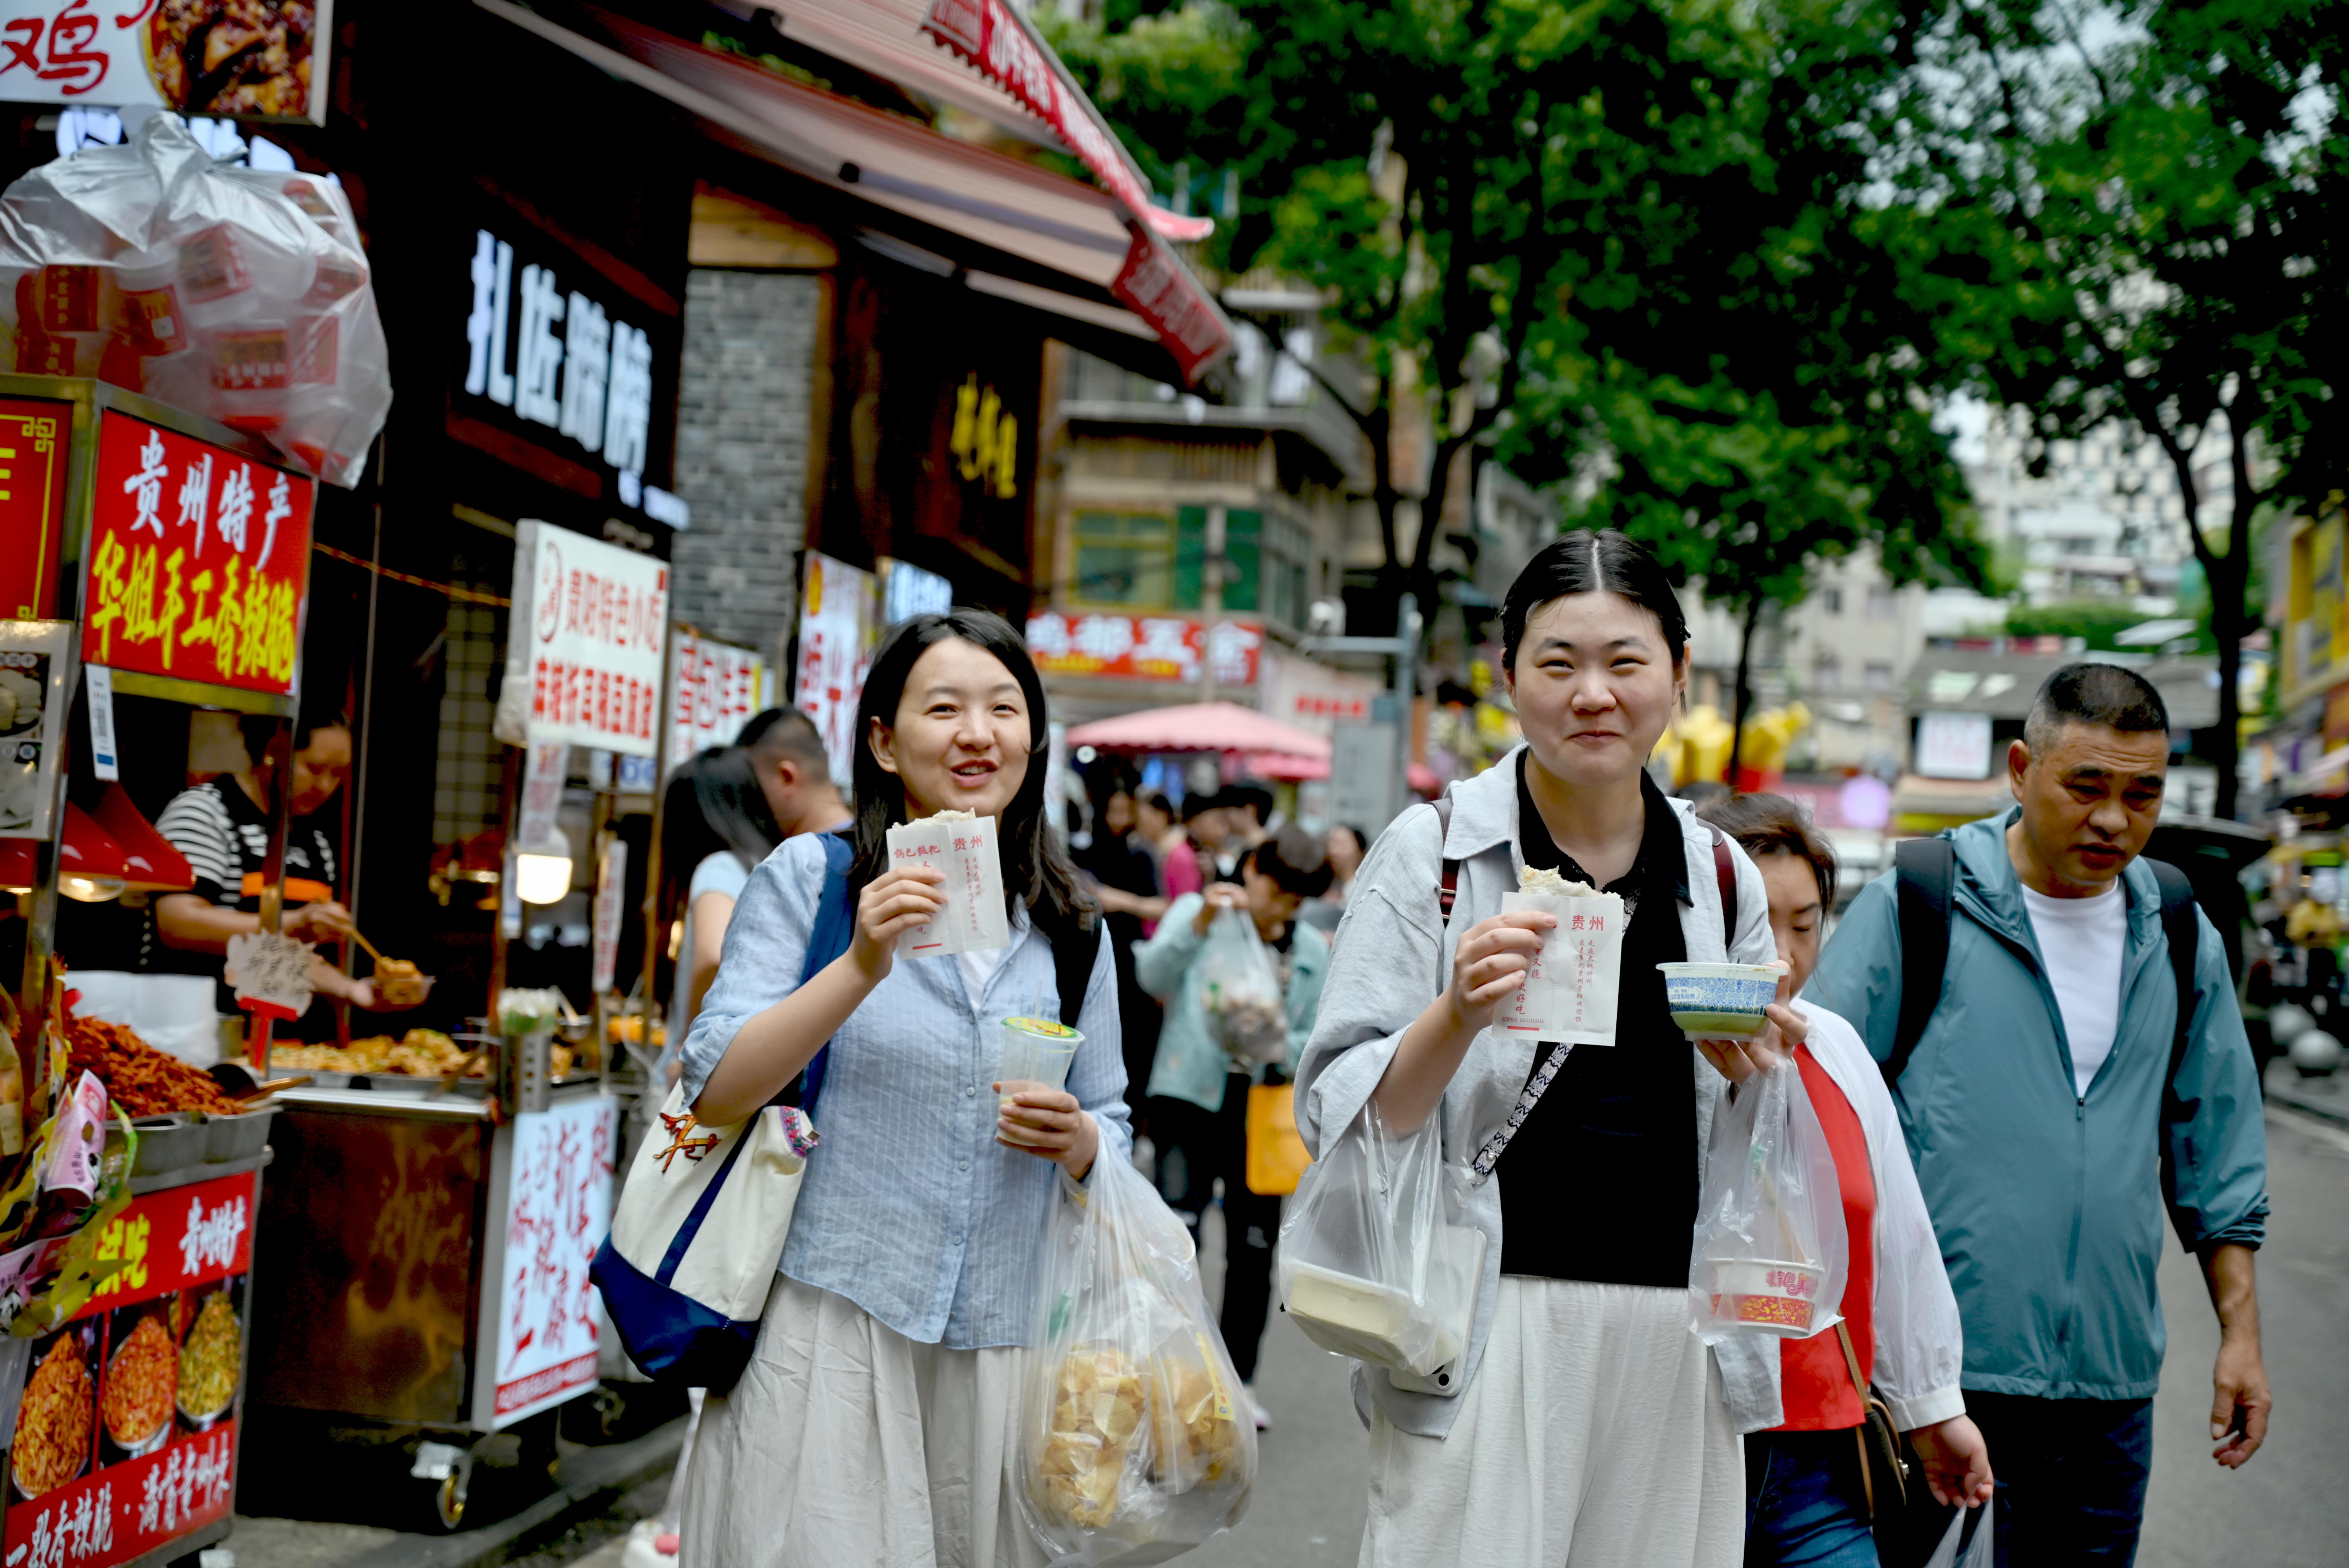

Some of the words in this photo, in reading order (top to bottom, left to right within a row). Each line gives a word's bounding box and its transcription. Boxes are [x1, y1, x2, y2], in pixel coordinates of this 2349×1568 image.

[123, 428, 292, 572] 贵州特产
[954, 835, 983, 851] 贵州
[1572, 915, 1604, 931] 贵州
[1515, 977, 1526, 1015] 更好吃
[1575, 939, 1585, 1022] 最美多彩贵州贵阳欢迎你
[179, 1195, 246, 1276] 贵州特产
